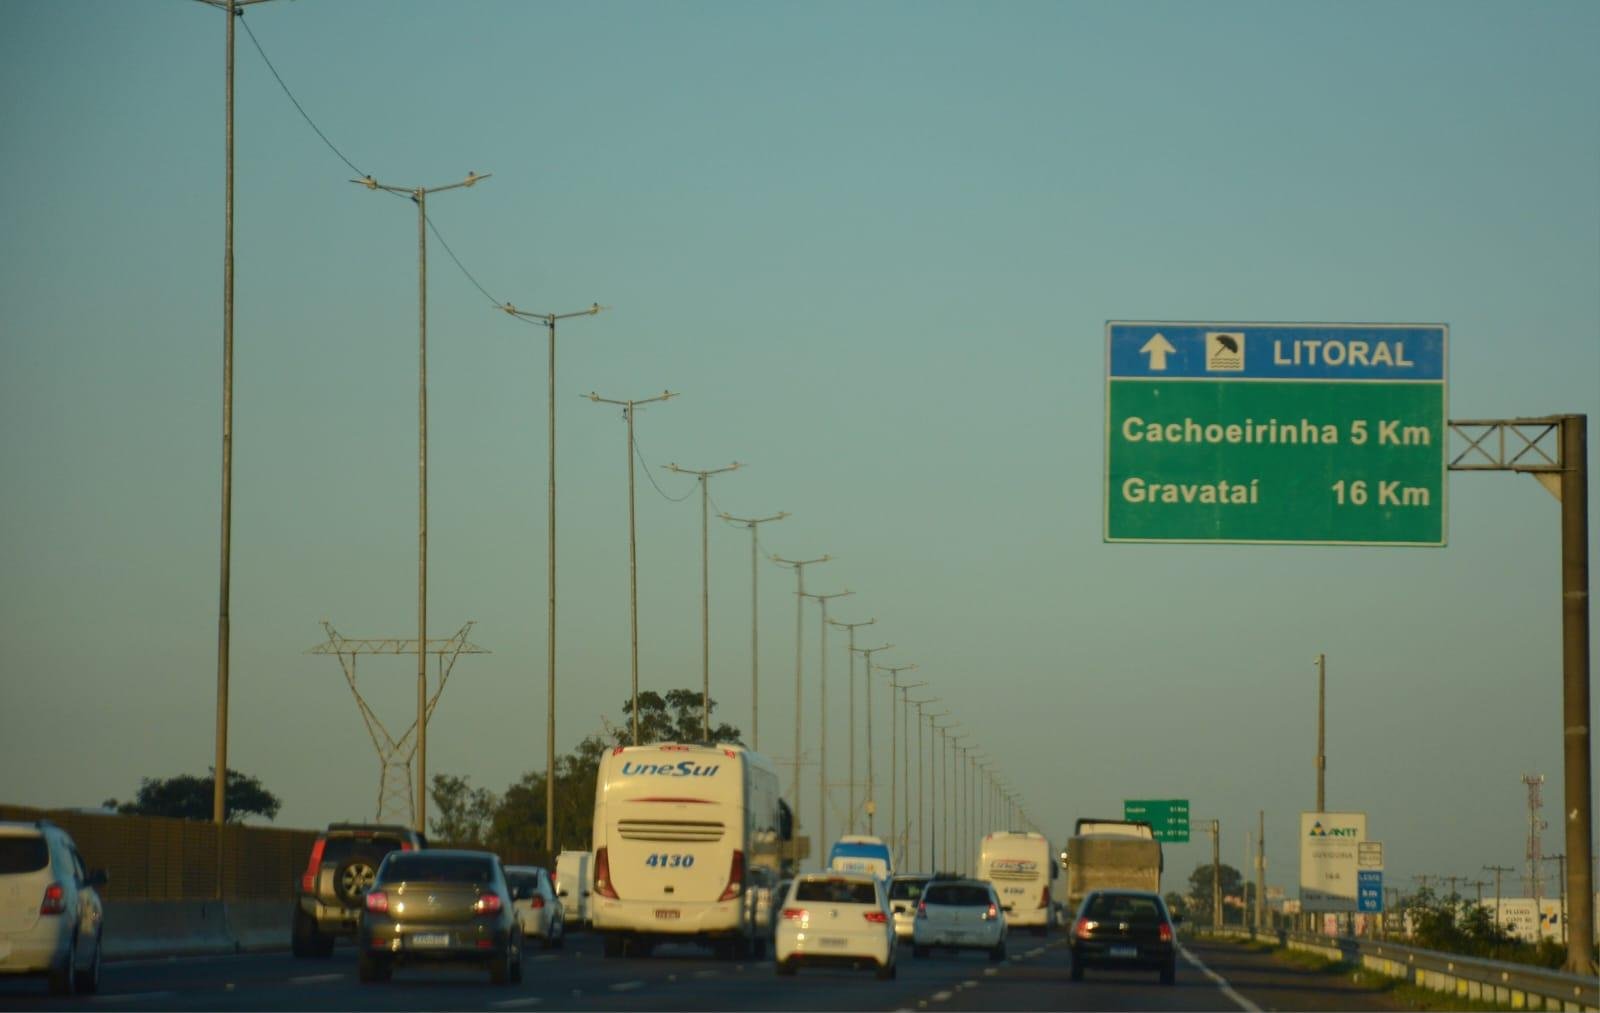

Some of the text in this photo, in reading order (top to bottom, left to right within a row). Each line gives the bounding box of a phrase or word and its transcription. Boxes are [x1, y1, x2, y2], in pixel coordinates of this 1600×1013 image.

[1273, 340, 1415, 368] LITORAL
[1121, 416, 1431, 446] Cachoeirinha 5 Km
[1121, 476, 1430, 507] Gravataí 16 Km
[1328, 828, 1358, 837] ANTT
[645, 852, 695, 869] 4130
